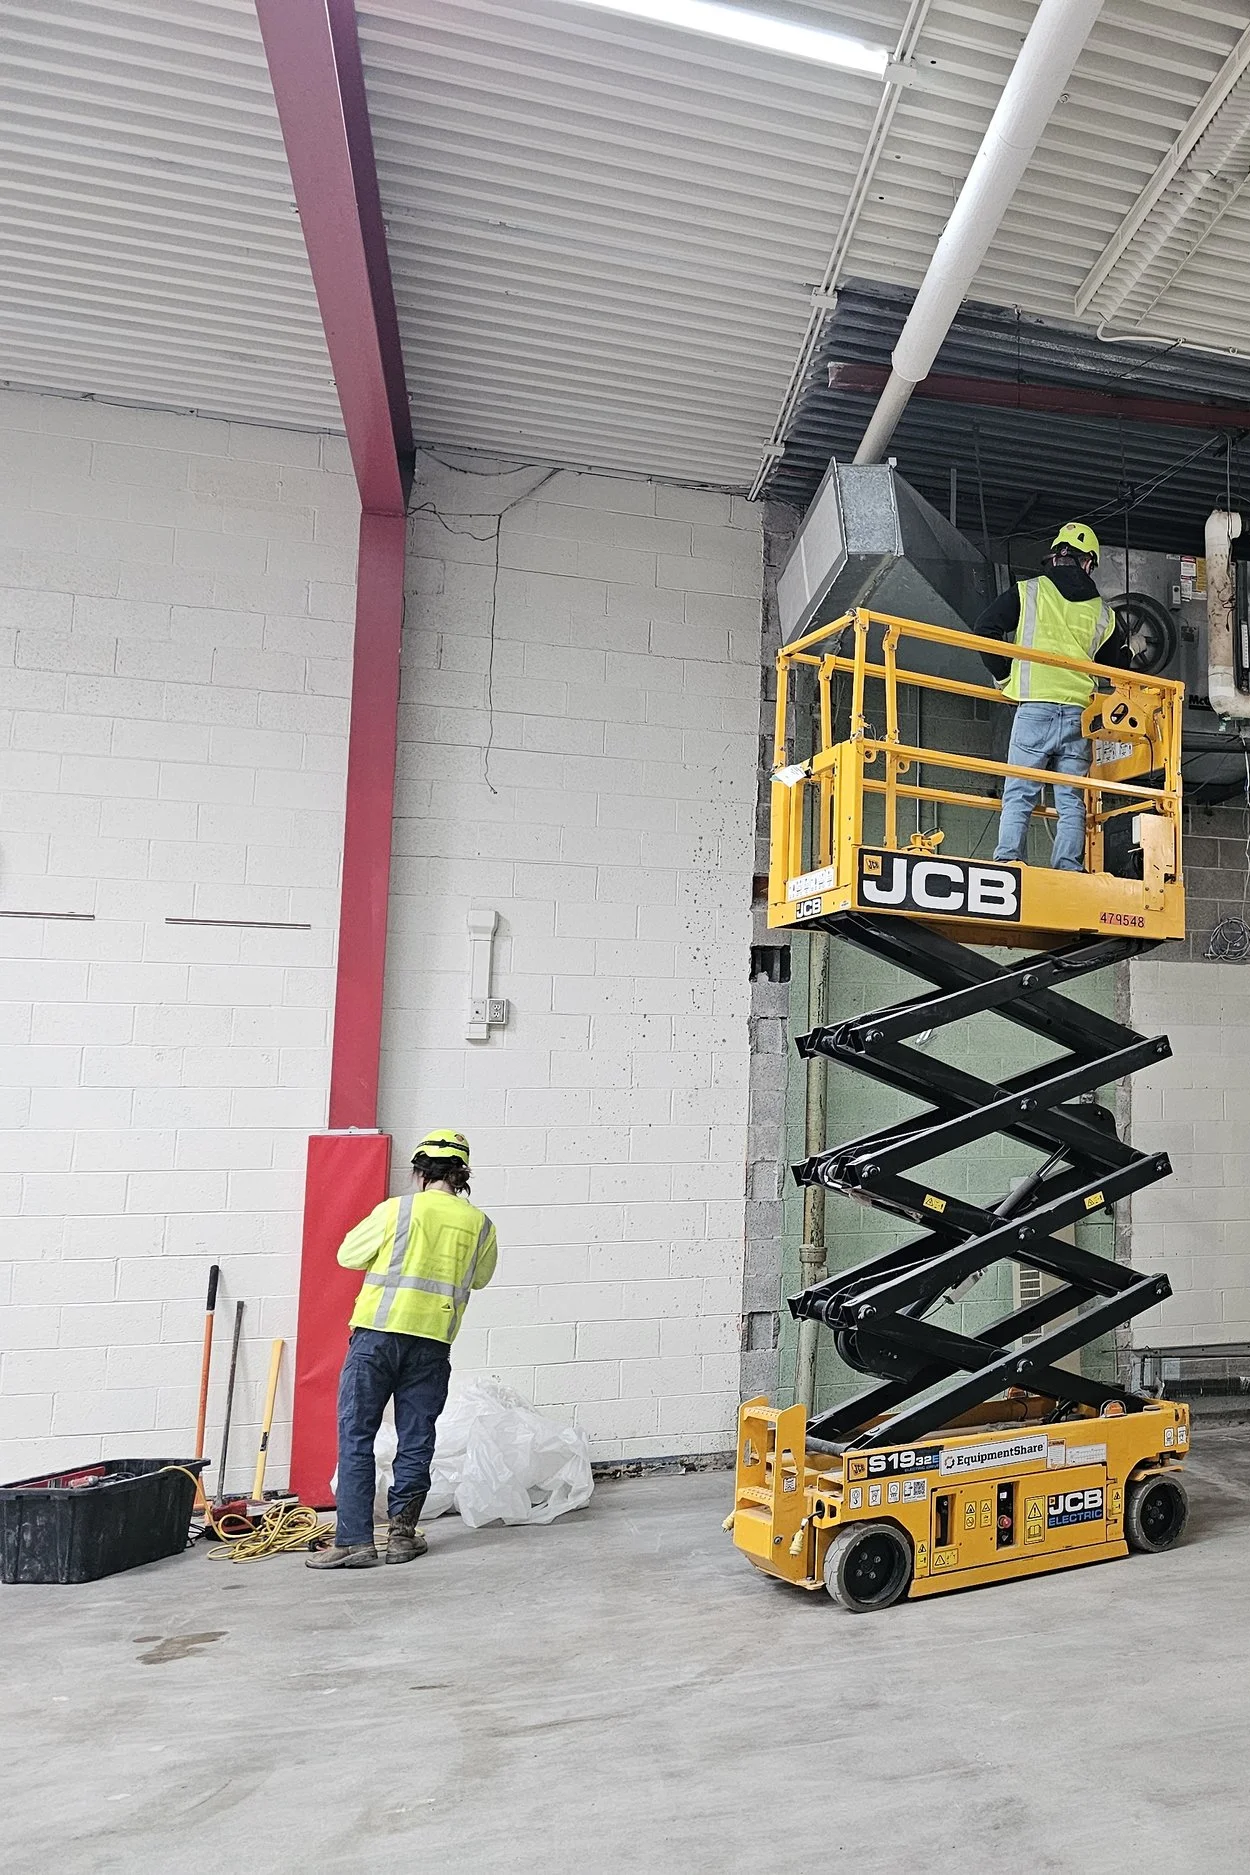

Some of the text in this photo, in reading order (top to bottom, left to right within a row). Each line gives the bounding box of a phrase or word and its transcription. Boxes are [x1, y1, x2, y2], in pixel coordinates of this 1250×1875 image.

[862, 857, 1018, 916] JCB
[796, 898, 821, 918] JCB
[1100, 912, 1145, 928] 479548
[956, 1442, 1044, 1466] EquipmentShare
[1048, 1489, 1103, 1515] JCB
[1048, 1508, 1103, 1527] ELECTRIC
